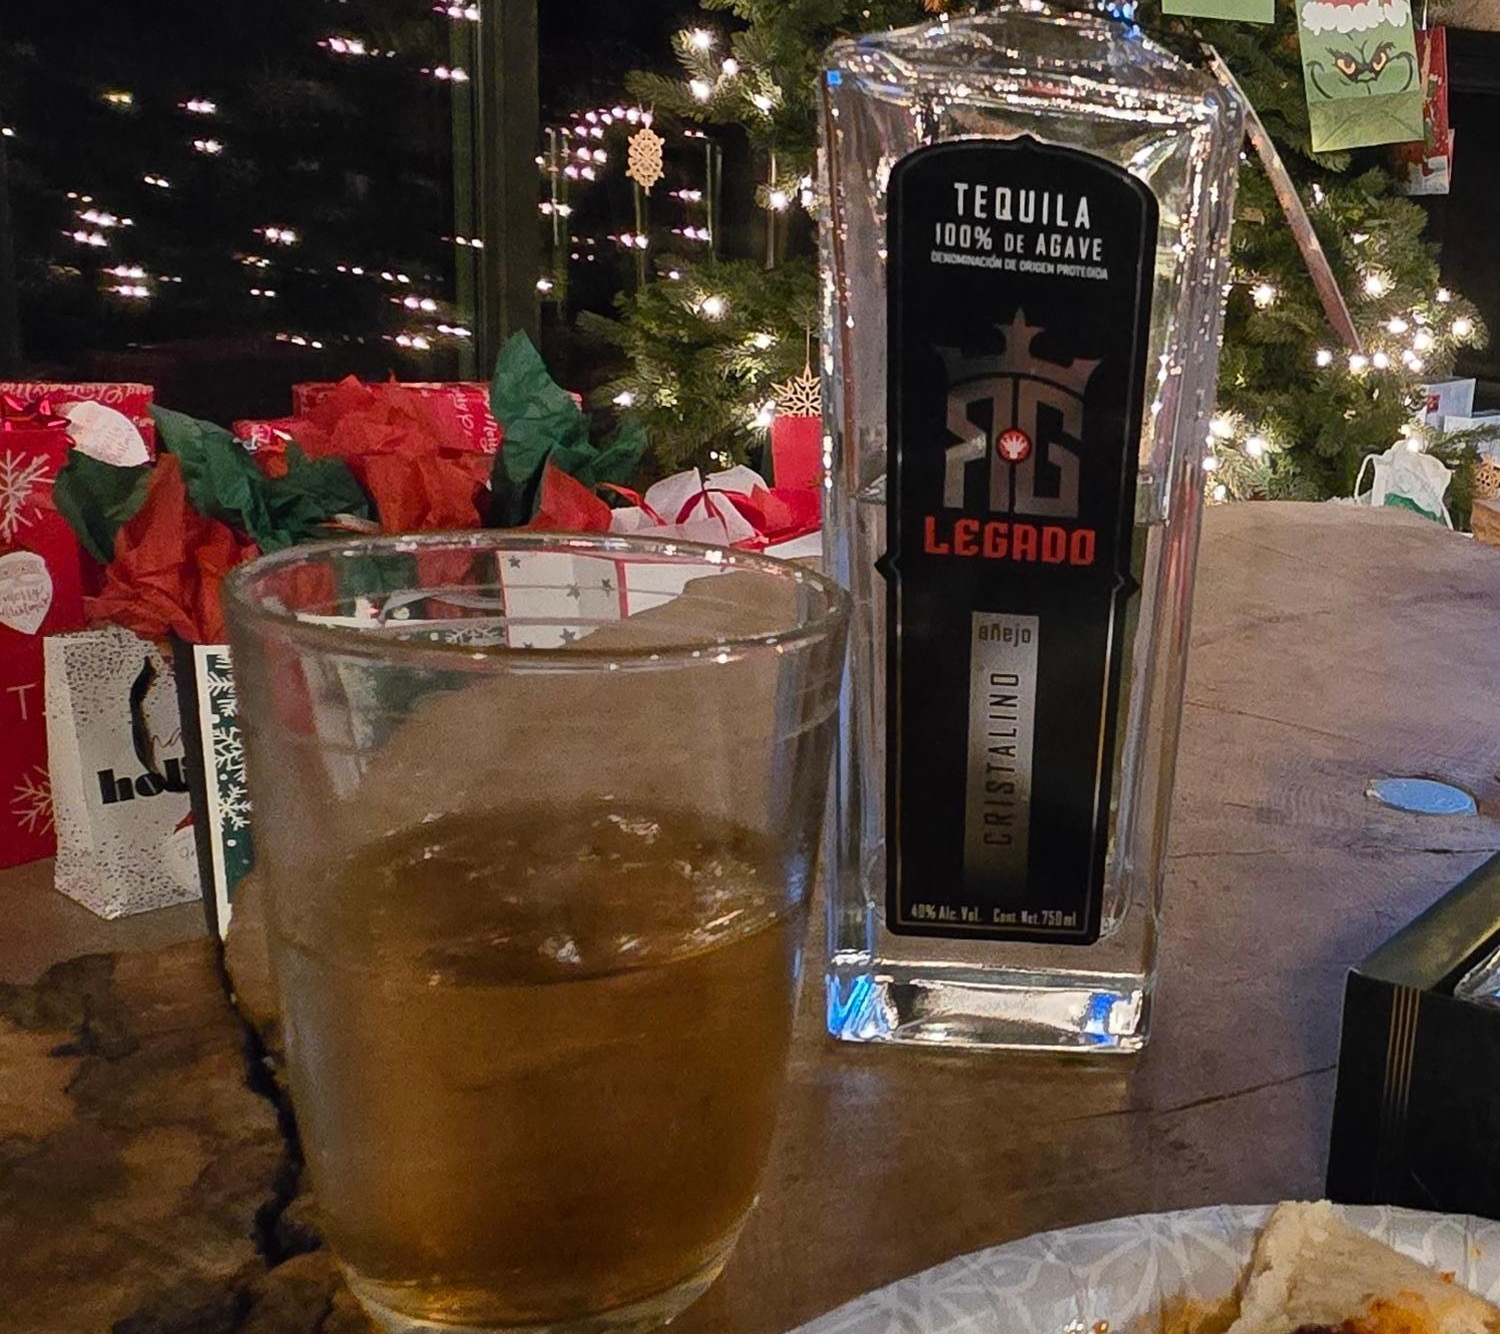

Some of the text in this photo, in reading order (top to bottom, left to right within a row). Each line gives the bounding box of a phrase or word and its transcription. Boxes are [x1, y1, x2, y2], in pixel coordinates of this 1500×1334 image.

[954, 182, 1090, 229] TEQUILA
[936, 223, 1103, 261] 100% DE AGAVE
[1004, 258, 1016, 271] DE
[1019, 260, 1054, 274] ORIGEN
[1056, 264, 1108, 280] PROTEGIDA
[924, 515, 1096, 566] LEGADO
[979, 623, 1031, 647] añejo
[983, 673, 1019, 847] CRISTALINO
[911, 904, 936, 919] 40%
